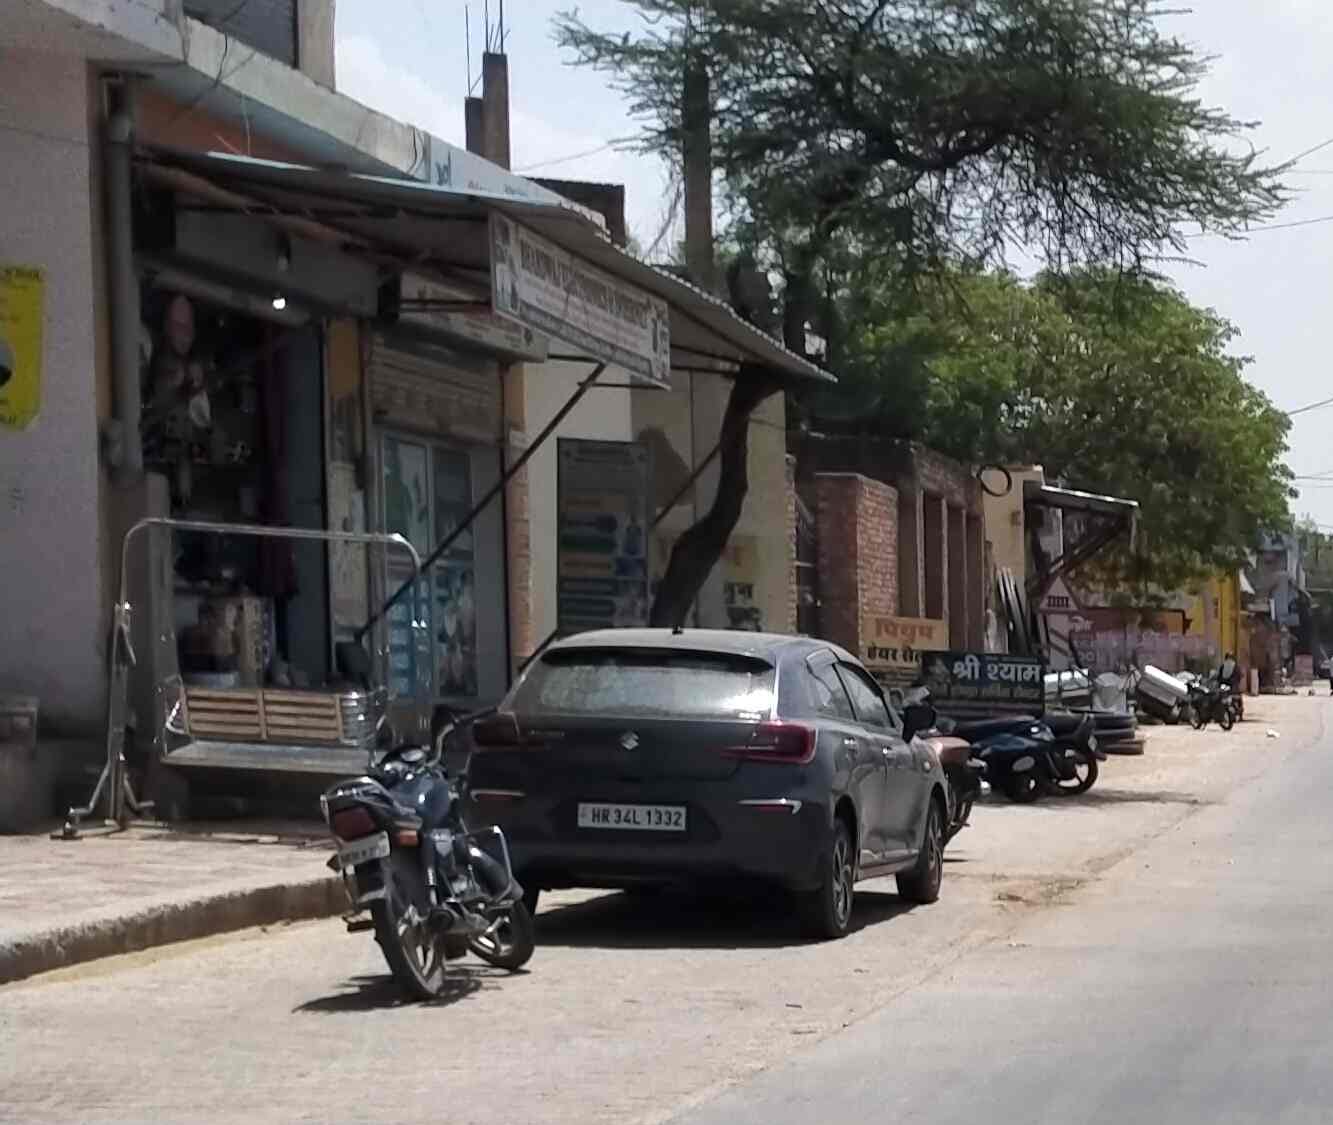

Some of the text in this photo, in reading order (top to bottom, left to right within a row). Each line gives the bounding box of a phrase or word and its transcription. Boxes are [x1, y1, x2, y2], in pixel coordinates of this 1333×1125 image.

[953, 654, 1042, 684] श्री श्याम
[591, 807, 610, 825] HR
